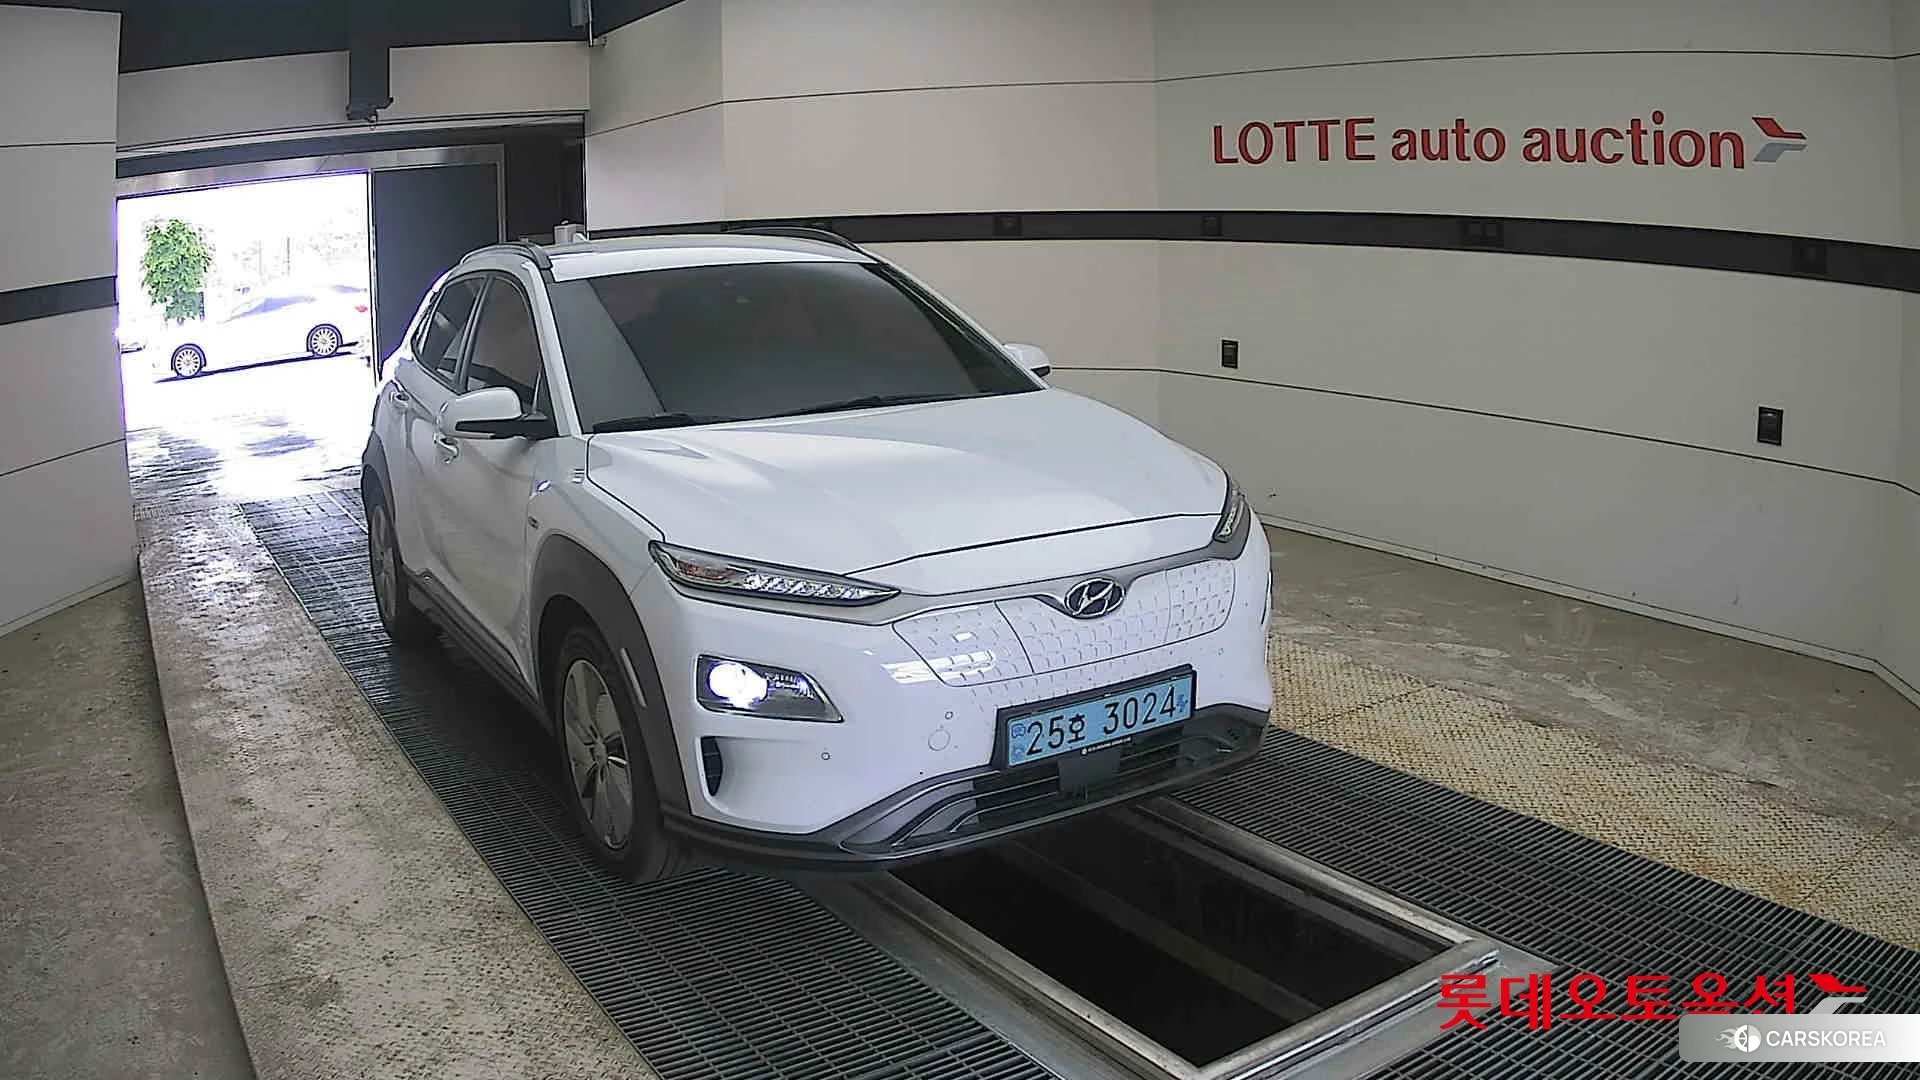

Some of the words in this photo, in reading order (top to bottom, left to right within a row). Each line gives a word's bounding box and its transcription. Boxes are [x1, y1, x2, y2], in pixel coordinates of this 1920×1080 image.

[1212, 116, 1377, 166] LOTTE
[1391, 118, 1507, 163] auto
[1521, 109, 1746, 170] auction
[1026, 713, 1086, 756] 25호
[1103, 685, 1176, 735] 3024
